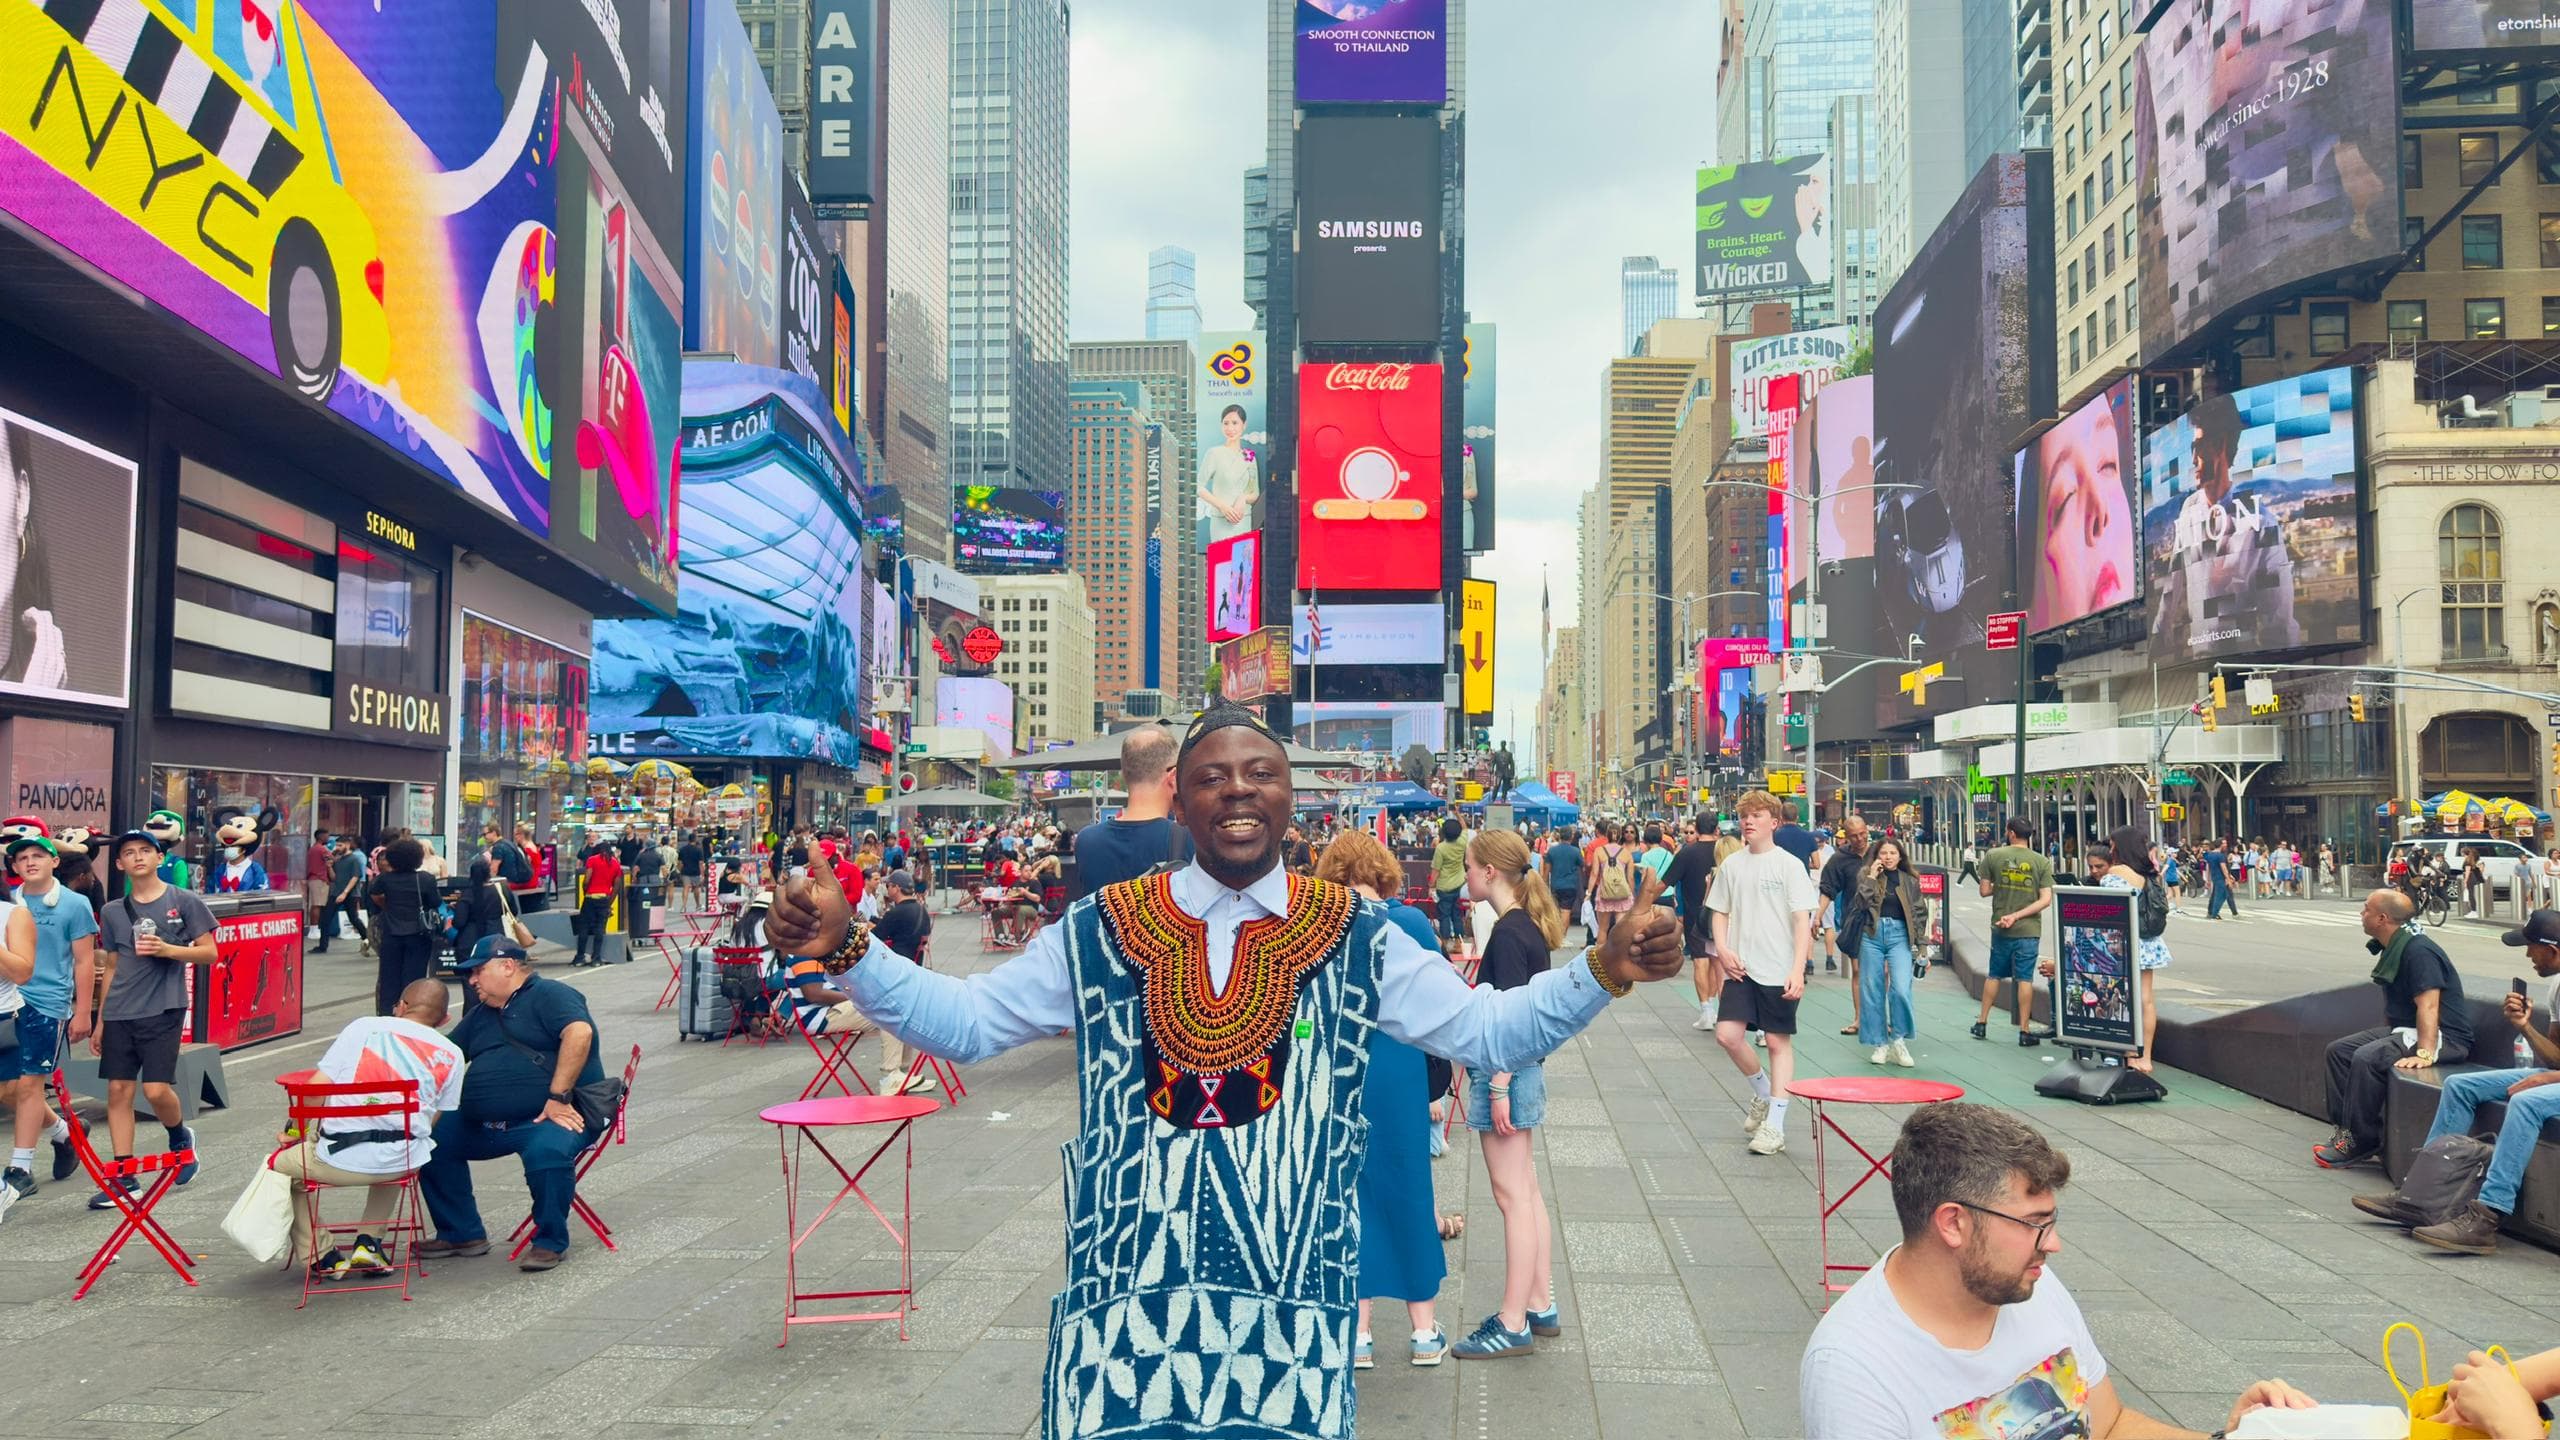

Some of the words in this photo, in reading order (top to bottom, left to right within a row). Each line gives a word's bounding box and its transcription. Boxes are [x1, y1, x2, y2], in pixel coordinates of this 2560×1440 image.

[1308, 30, 1358, 40] SMOOTH
[1361, 30, 1436, 40] CONNECTION
[1334, 43, 1349, 52] TO
[1352, 43, 1410, 52] THAILAND
[816, 12, 857, 157] ARE
[2232, 93, 2272, 130] since
[2277, 60, 2329, 104] 1928
[586, 79, 615, 137] MARRIOTT
[29, 44, 260, 278] NYC
[1318, 220, 1423, 238] SAMSUNG
[1707, 236, 1747, 249] Brains.
[1750, 230, 1786, 243] Heart.
[1353, 245, 1387, 254] presents
[1721, 245, 1772, 258] Courage.
[788, 231, 822, 352] 700
[1743, 337, 1799, 374] LITTLE
[1803, 336, 1845, 361] SHOP
[1325, 362, 1413, 391] Coca-Cola
[2417, 465, 2456, 481] THE
[2464, 464, 2521, 480] SHOW
[2532, 463, 2560, 480] FO
[366, 511, 416, 551] SEPHORA
[1338, 632, 1416, 641] WIMBLEDON
[1989, 626, 2009, 634] Anytime
[1724, 643, 1750, 652] CIRQUE
[1740, 653, 1771, 665] LUZIA
[349, 683, 441, 736] SEPHORA
[19, 783, 107, 812] PANDORA
[215, 925, 238, 943] OFF.
[238, 922, 262, 941] THE.
[262, 918, 298, 938] CHARTS.
